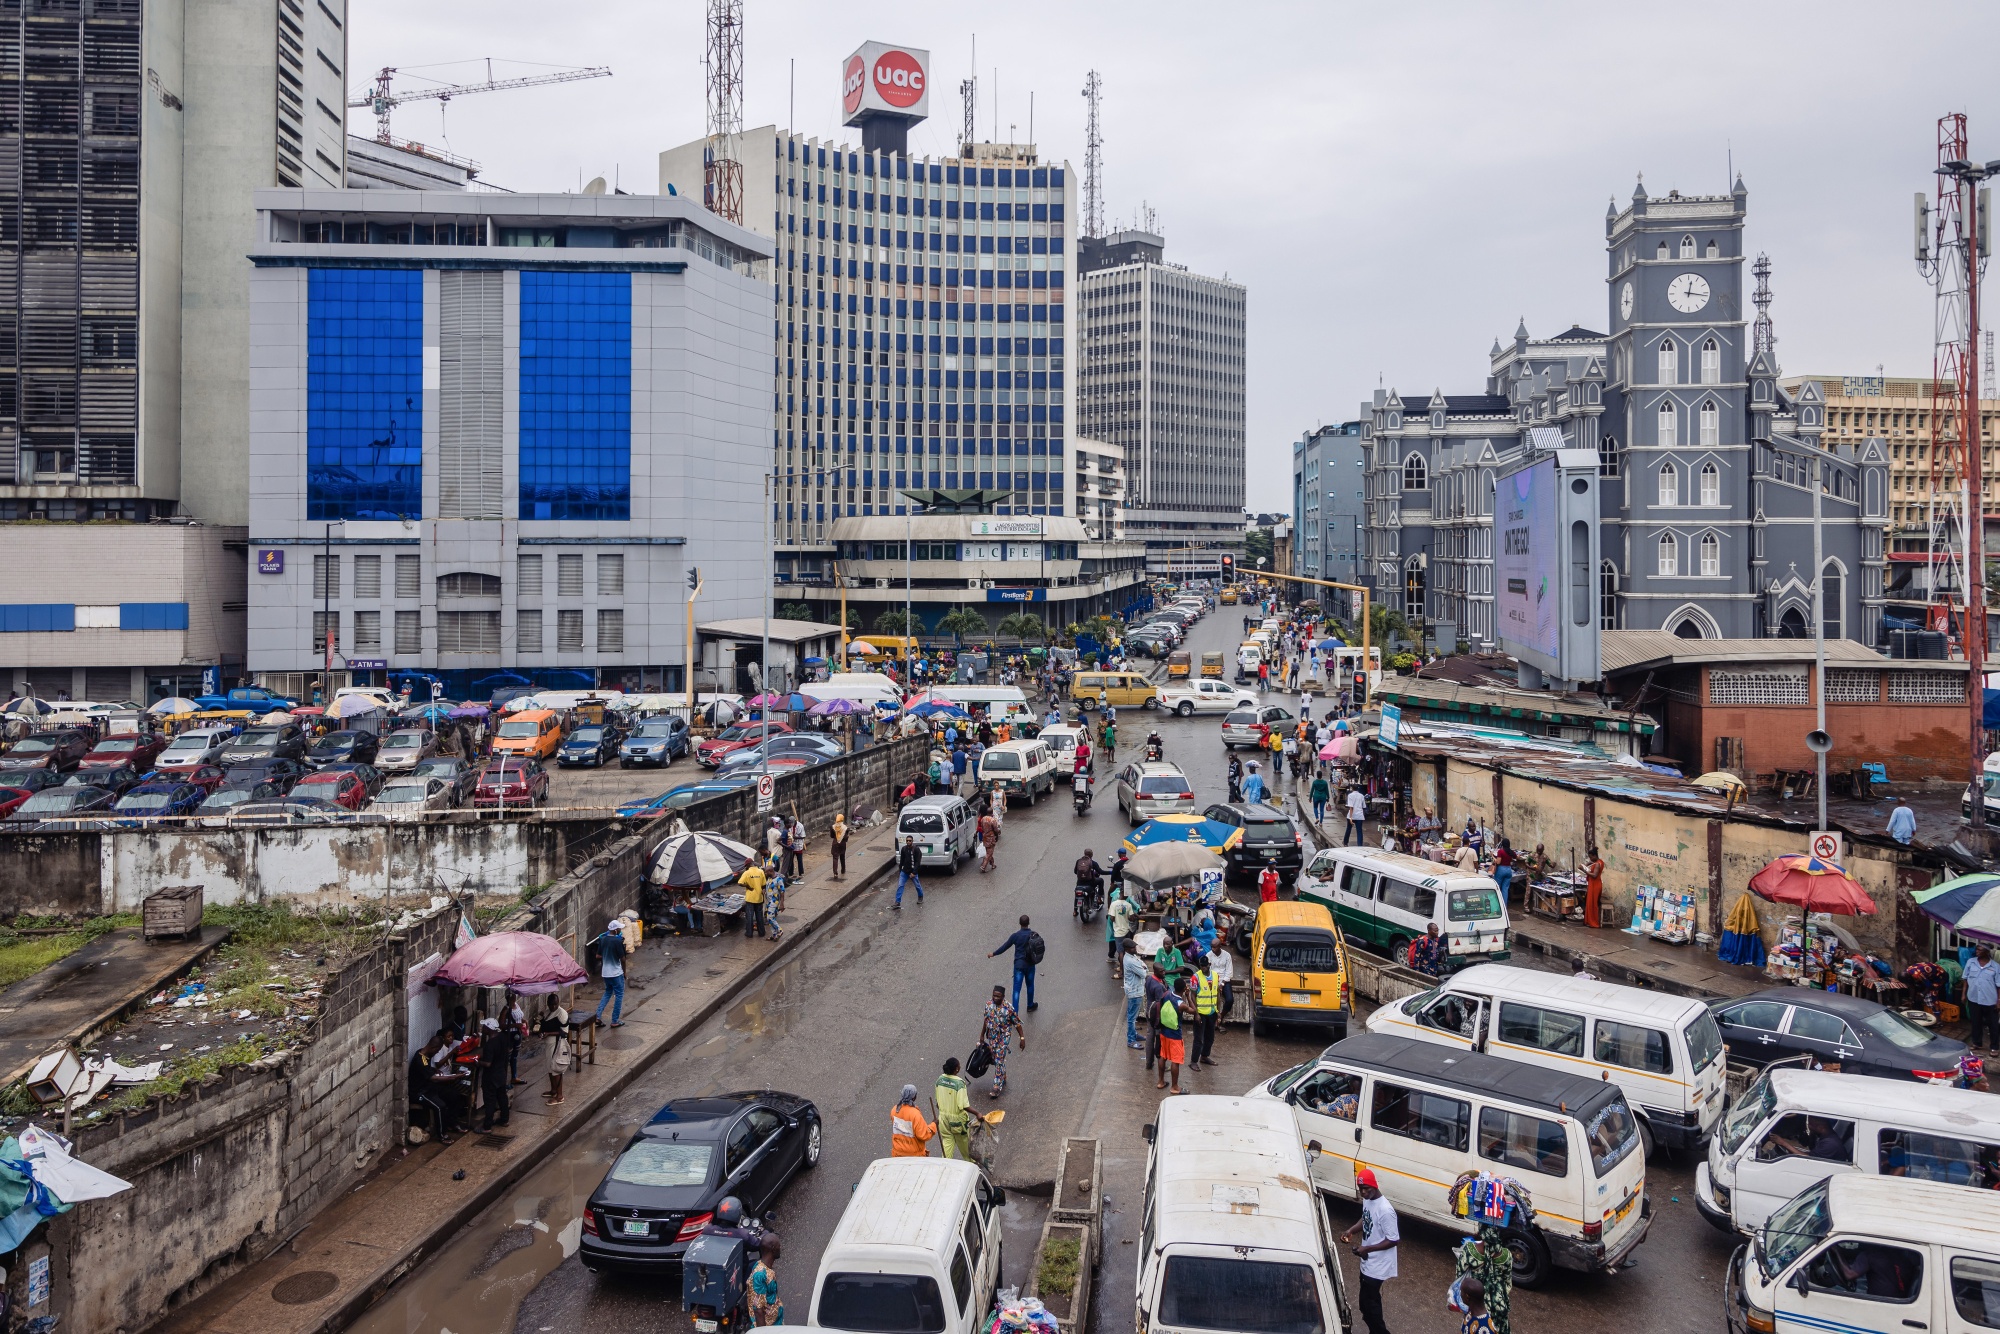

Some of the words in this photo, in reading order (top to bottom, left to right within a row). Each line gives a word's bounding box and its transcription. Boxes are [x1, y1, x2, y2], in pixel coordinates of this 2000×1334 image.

[876, 65, 923, 90] uac
[1843, 376, 1884, 388] CHURCH
[1625, 844, 1639, 852] KEEP
[1640, 848, 1658, 857] LAGOS
[1660, 852, 1678, 862] CLEAN
